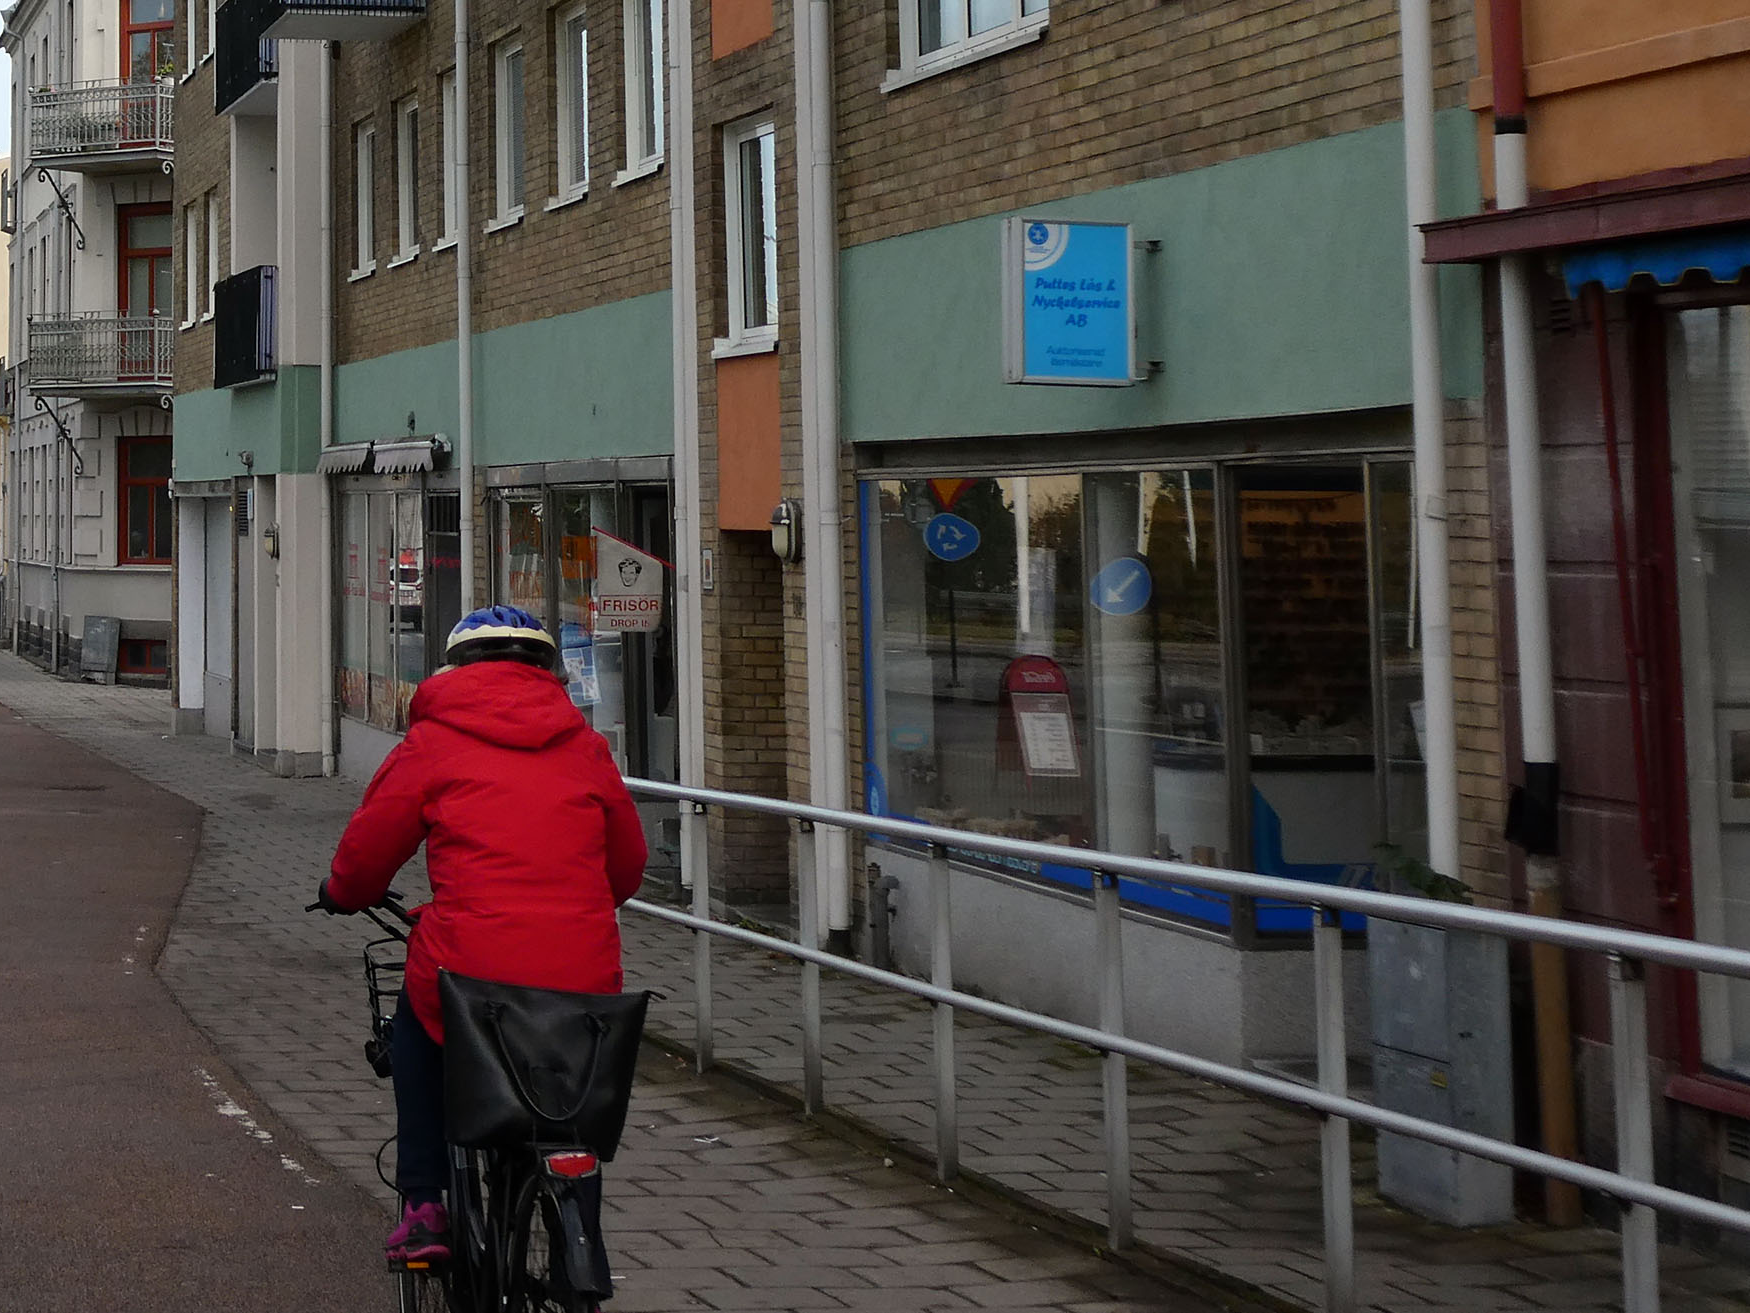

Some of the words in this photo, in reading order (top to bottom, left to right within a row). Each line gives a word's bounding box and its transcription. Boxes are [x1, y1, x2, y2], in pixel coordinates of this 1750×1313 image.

[1065, 314, 1088, 328] AB
[602, 597, 659, 612] FRISÖR
[610, 619, 638, 627] DROP
